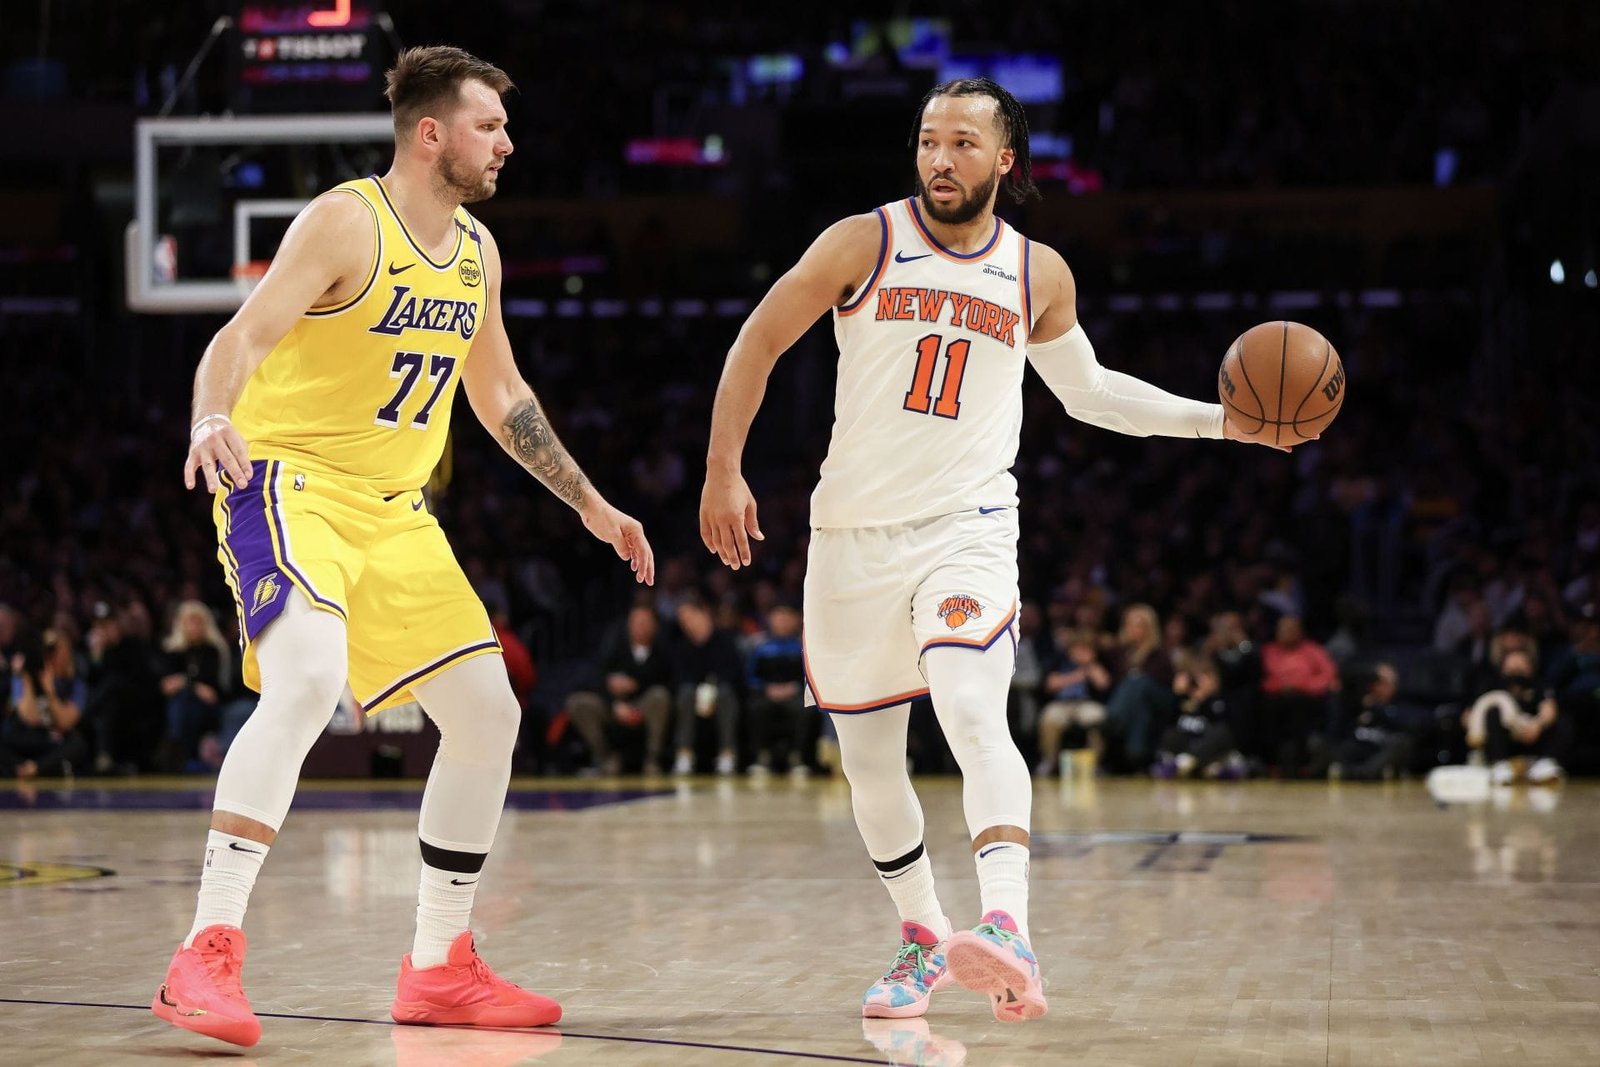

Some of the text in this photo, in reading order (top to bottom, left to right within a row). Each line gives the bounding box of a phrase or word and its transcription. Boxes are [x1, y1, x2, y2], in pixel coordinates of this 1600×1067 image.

[368, 285, 478, 341] LAKERS
[875, 288, 1020, 349] NEW YORK
[374, 351, 457, 430] 77
[903, 333, 971, 420] 11
[937, 597, 982, 619] KNICKS
